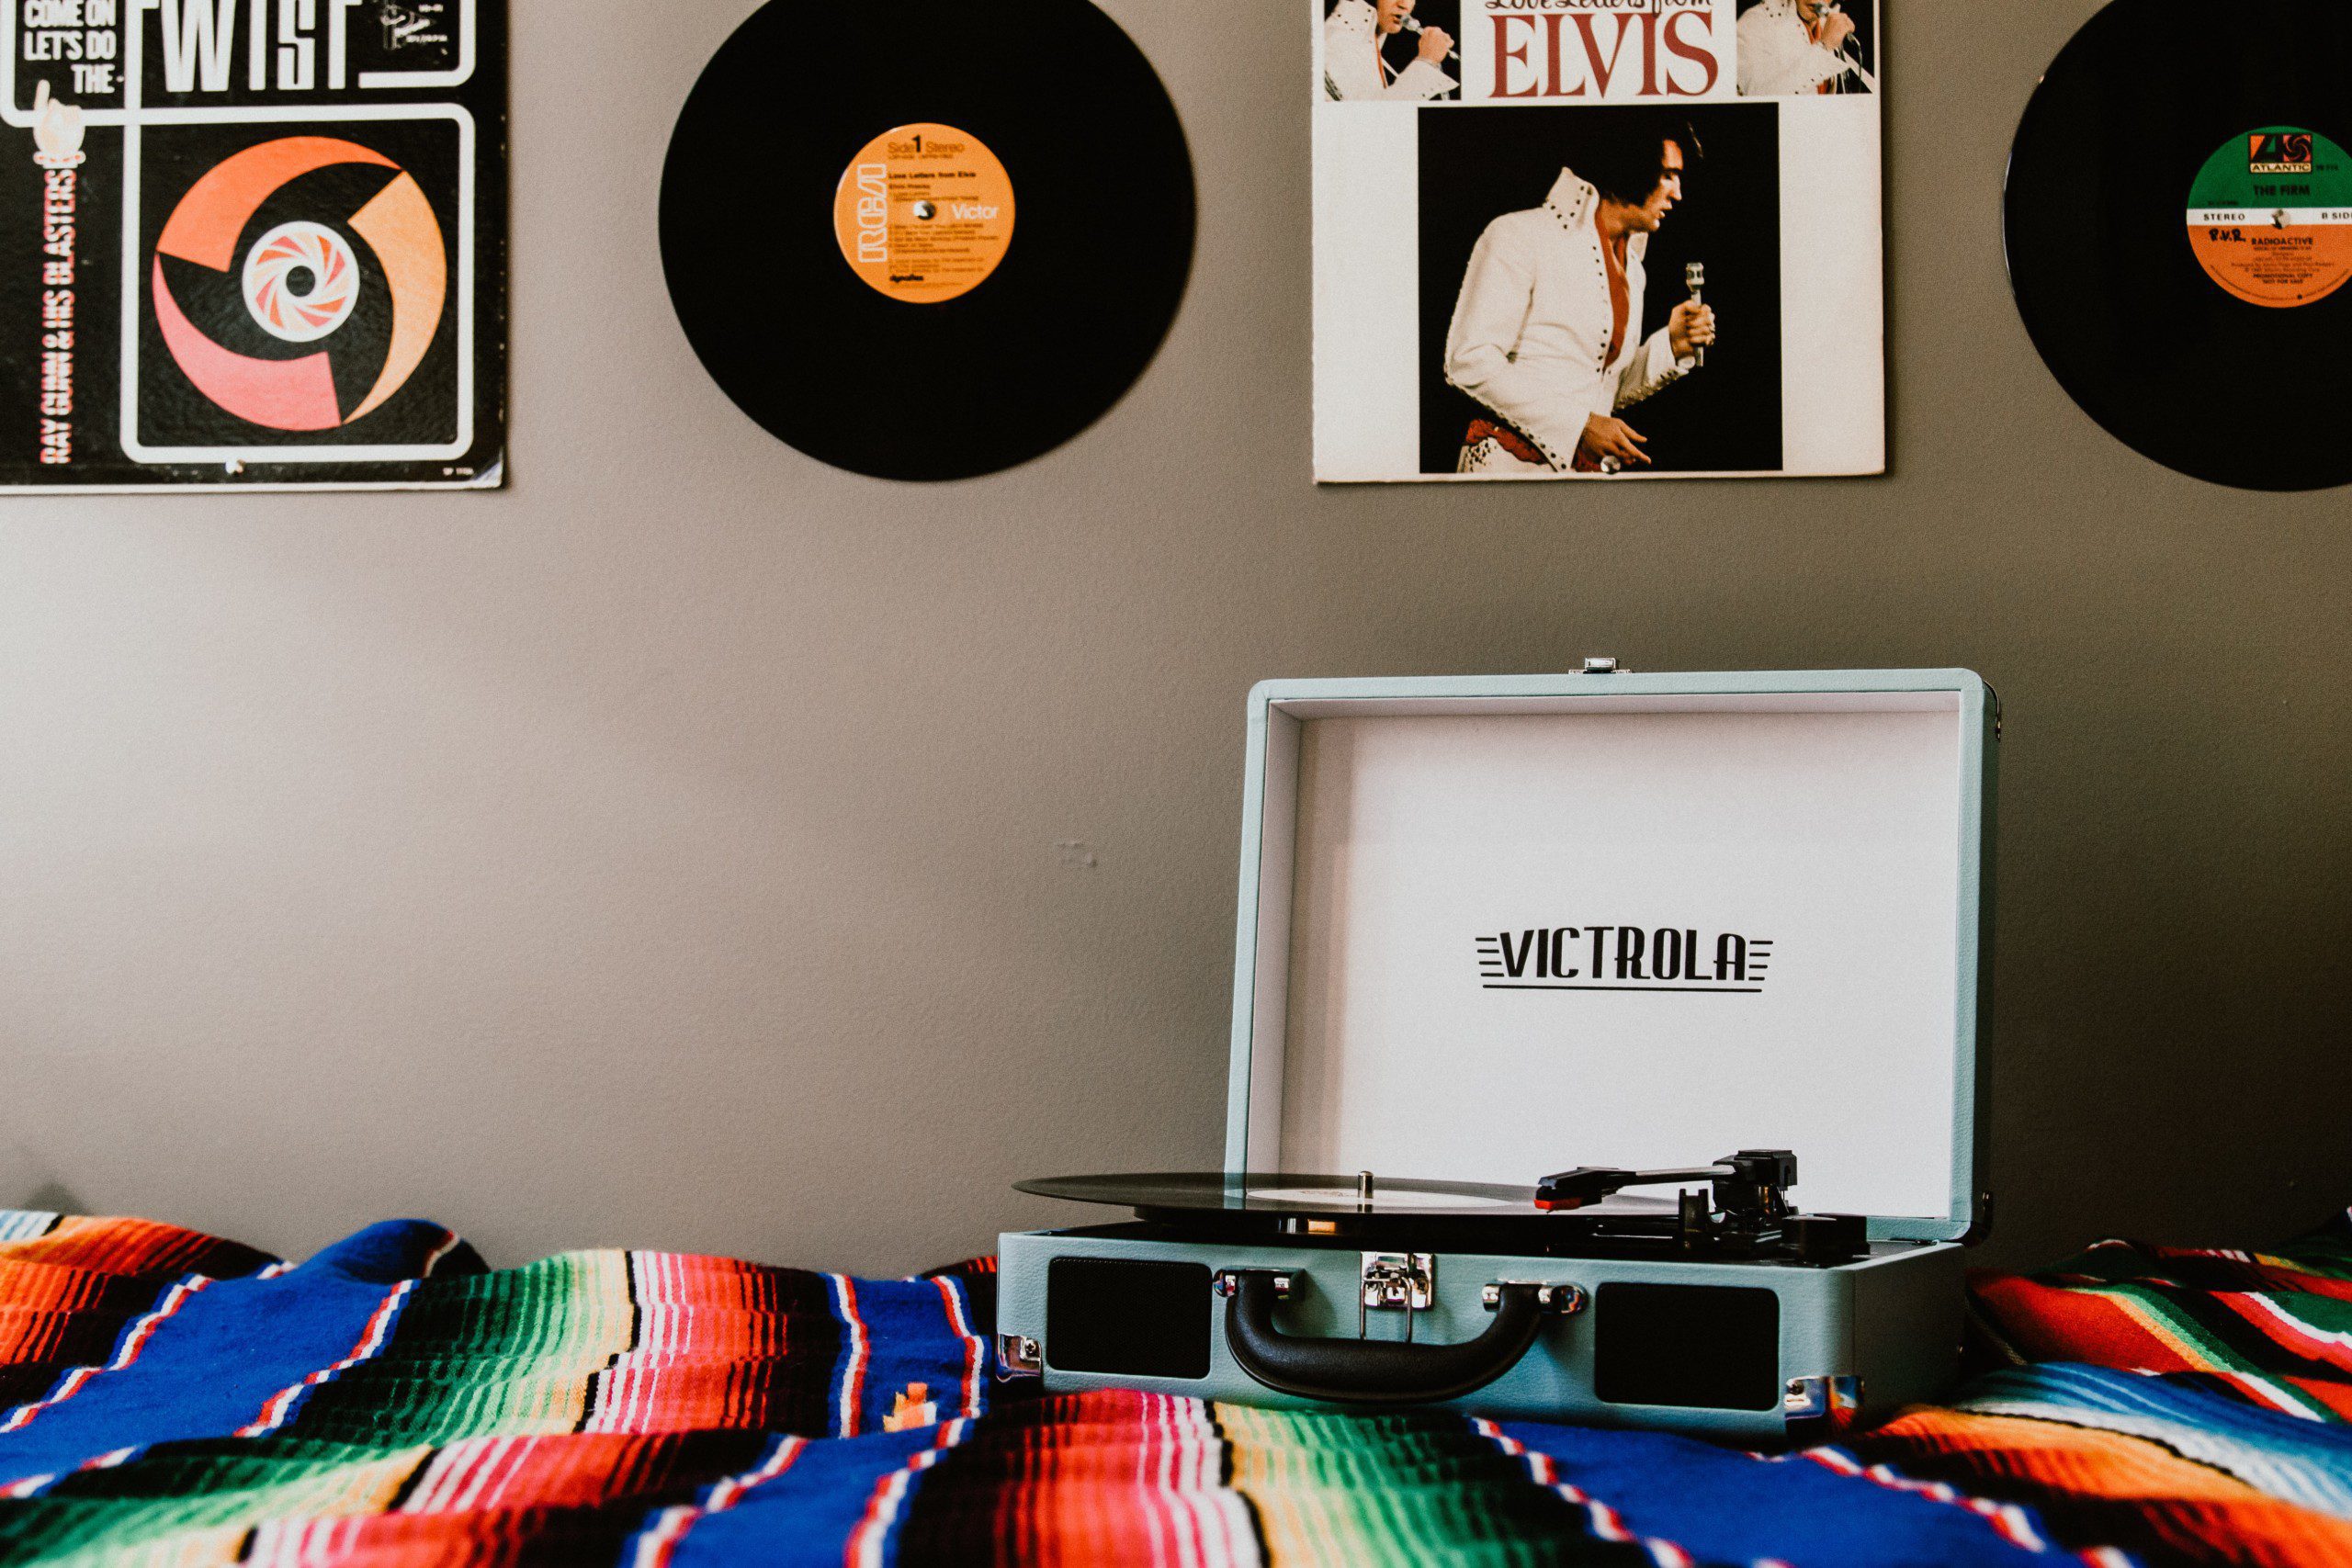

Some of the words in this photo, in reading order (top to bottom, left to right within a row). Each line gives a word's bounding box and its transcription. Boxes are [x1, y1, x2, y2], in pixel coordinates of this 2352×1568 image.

[85, 0, 116, 27] ON
[24, 30, 83, 61] LET'S
[85, 29, 117, 60] DO
[1487, 10, 1718, 98] ELVIS
[71, 63, 116, 94] THE
[911, 134, 922, 152] 1
[925, 141, 965, 152] Stereo
[2254, 185, 2276, 196] THE
[2279, 185, 2311, 196] FIRM
[43, 169, 76, 286] BLASTERS
[857, 164, 888, 263] RCA
[951, 203, 999, 220] Victor
[2251, 237, 2313, 245] RADIOACTIVE
[42, 288, 75, 329] HIS
[42, 330, 74, 350] &
[40, 351, 74, 416] GUNN
[40, 418, 72, 464] RAY
[1499, 926, 1746, 981] VICTROLA
